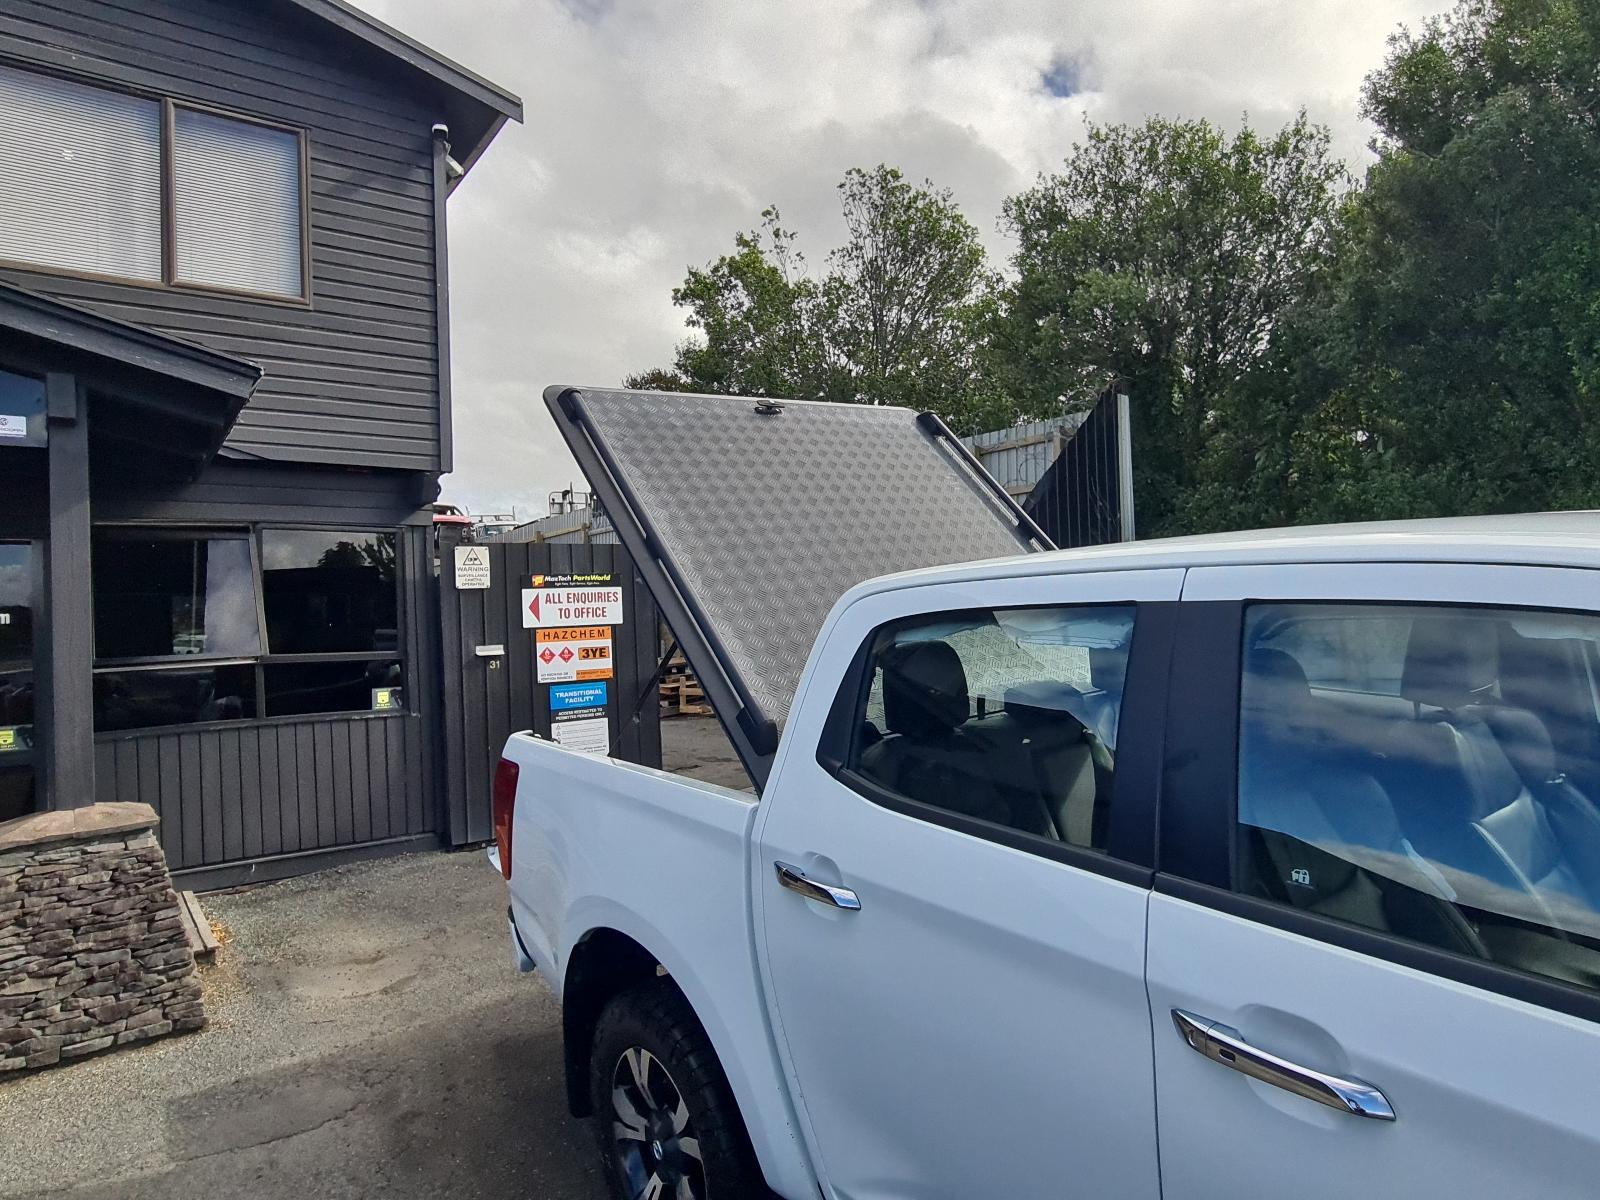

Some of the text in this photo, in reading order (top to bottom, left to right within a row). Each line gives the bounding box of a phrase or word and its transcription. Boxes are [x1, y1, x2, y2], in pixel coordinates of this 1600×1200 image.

[545, 592, 619, 605] ALL ENQUIRIES
[558, 607, 607, 619] TO OFFICE
[543, 629, 605, 640] HAZCHEM
[582, 647, 607, 659] 3YE
[490, 660, 500, 669] 31
[555, 688, 603, 698] TRANSITIONAL
[565, 696, 595, 704] FACILITY
